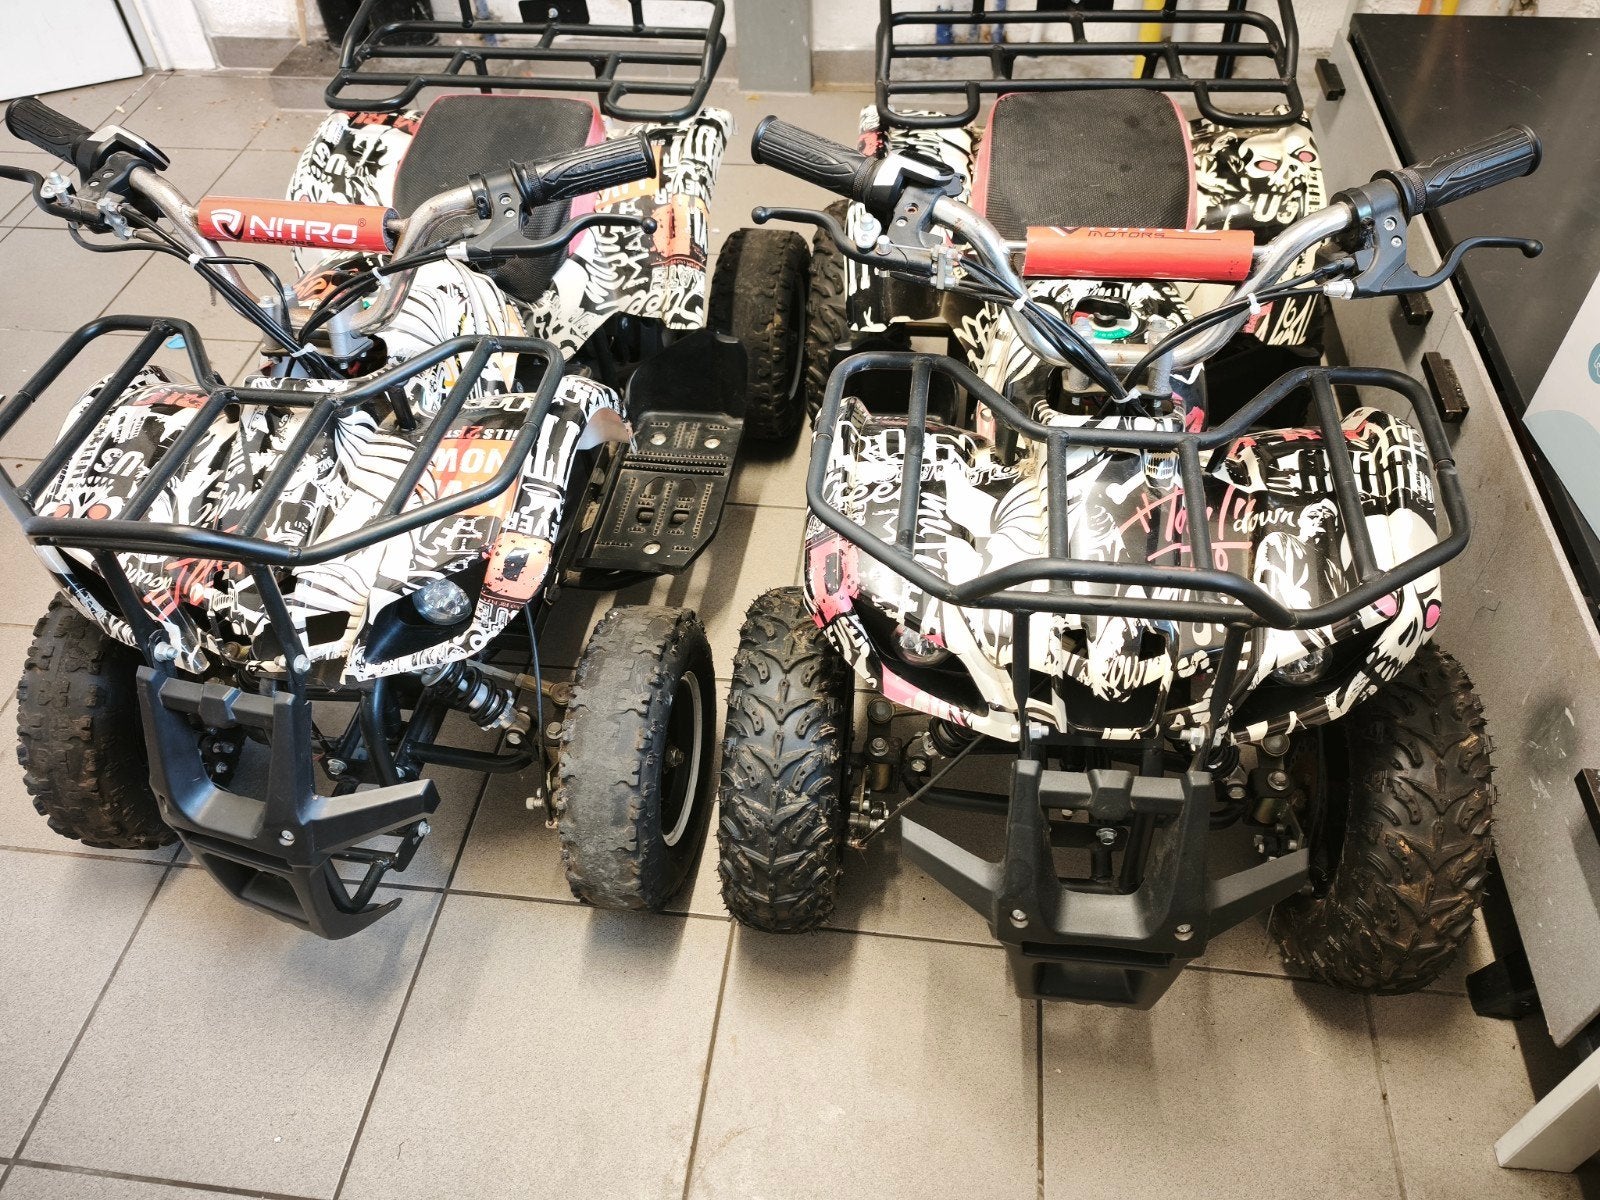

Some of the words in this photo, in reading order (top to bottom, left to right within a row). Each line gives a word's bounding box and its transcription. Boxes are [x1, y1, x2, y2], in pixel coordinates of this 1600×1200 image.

[249, 214, 359, 245] NITRO
[1087, 229, 1166, 240] MOTORS
[1232, 506, 1298, 534] down
